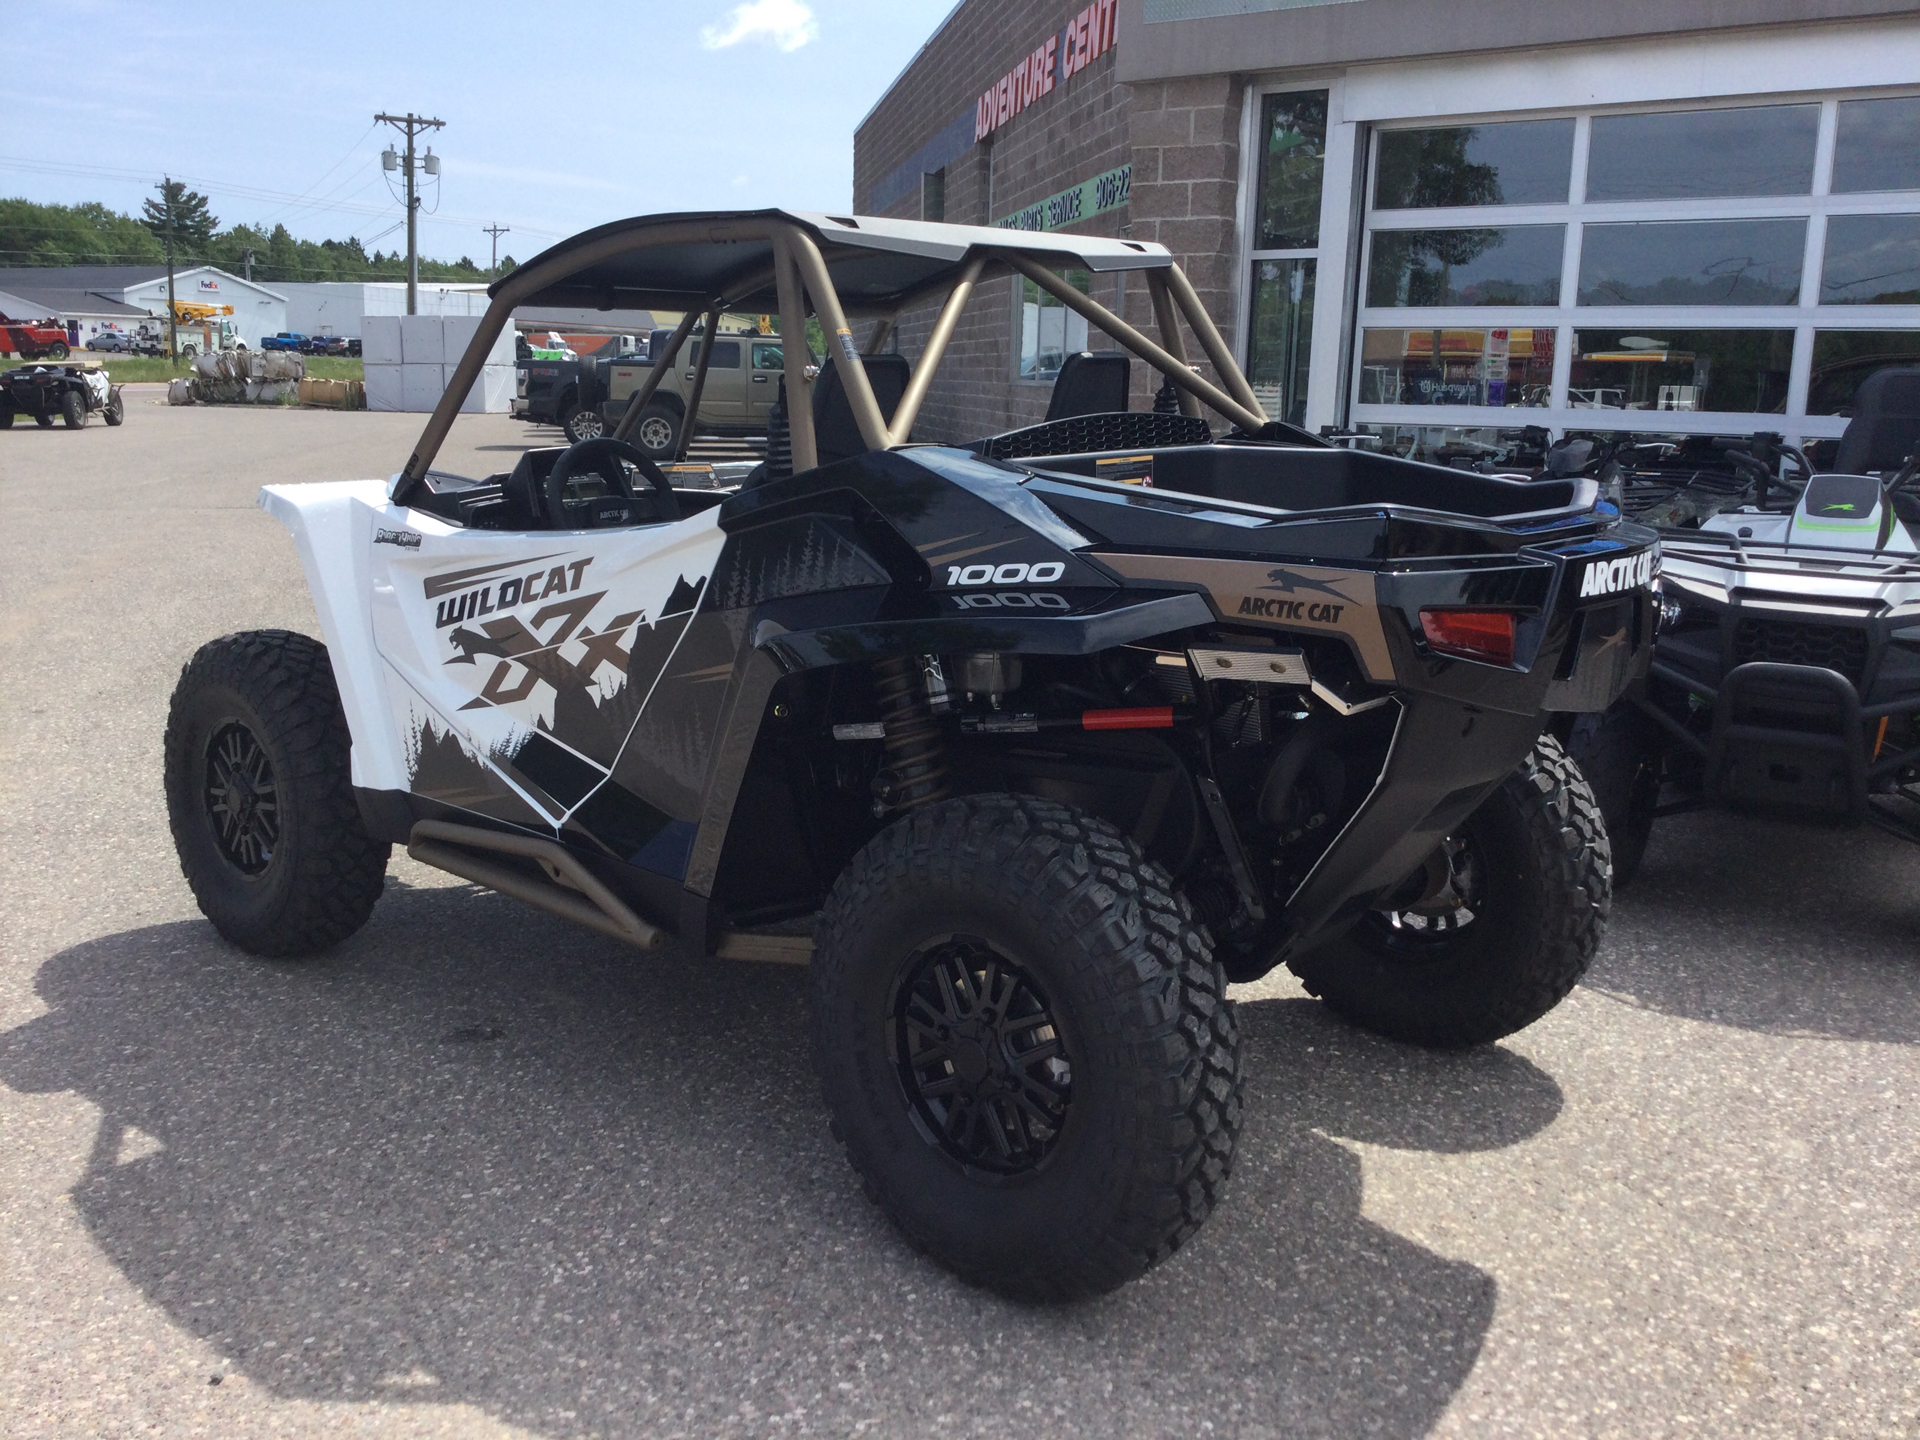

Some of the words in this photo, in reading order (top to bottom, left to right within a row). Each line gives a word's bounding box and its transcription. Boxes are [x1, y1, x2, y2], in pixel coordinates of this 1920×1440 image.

[974, 35, 1058, 143] ADVENTURE
[1062, 0, 1119, 79] CENT
[1020, 204, 1043, 231] PARTS
[1047, 188, 1082, 228] SERVICE
[201, 280, 219, 289] FedEx
[101, 322, 118, 330] FedEx
[600, 510, 620, 520] ARCTIC
[947, 562, 1066, 585] 1000
[1580, 556, 1638, 597] ARCTIC
[1637, 550, 1653, 586] CAT
[435, 556, 595, 629] WILDCAT
[1238, 596, 1305, 620] ARCTIC
[1308, 603, 1344, 624] CAT
